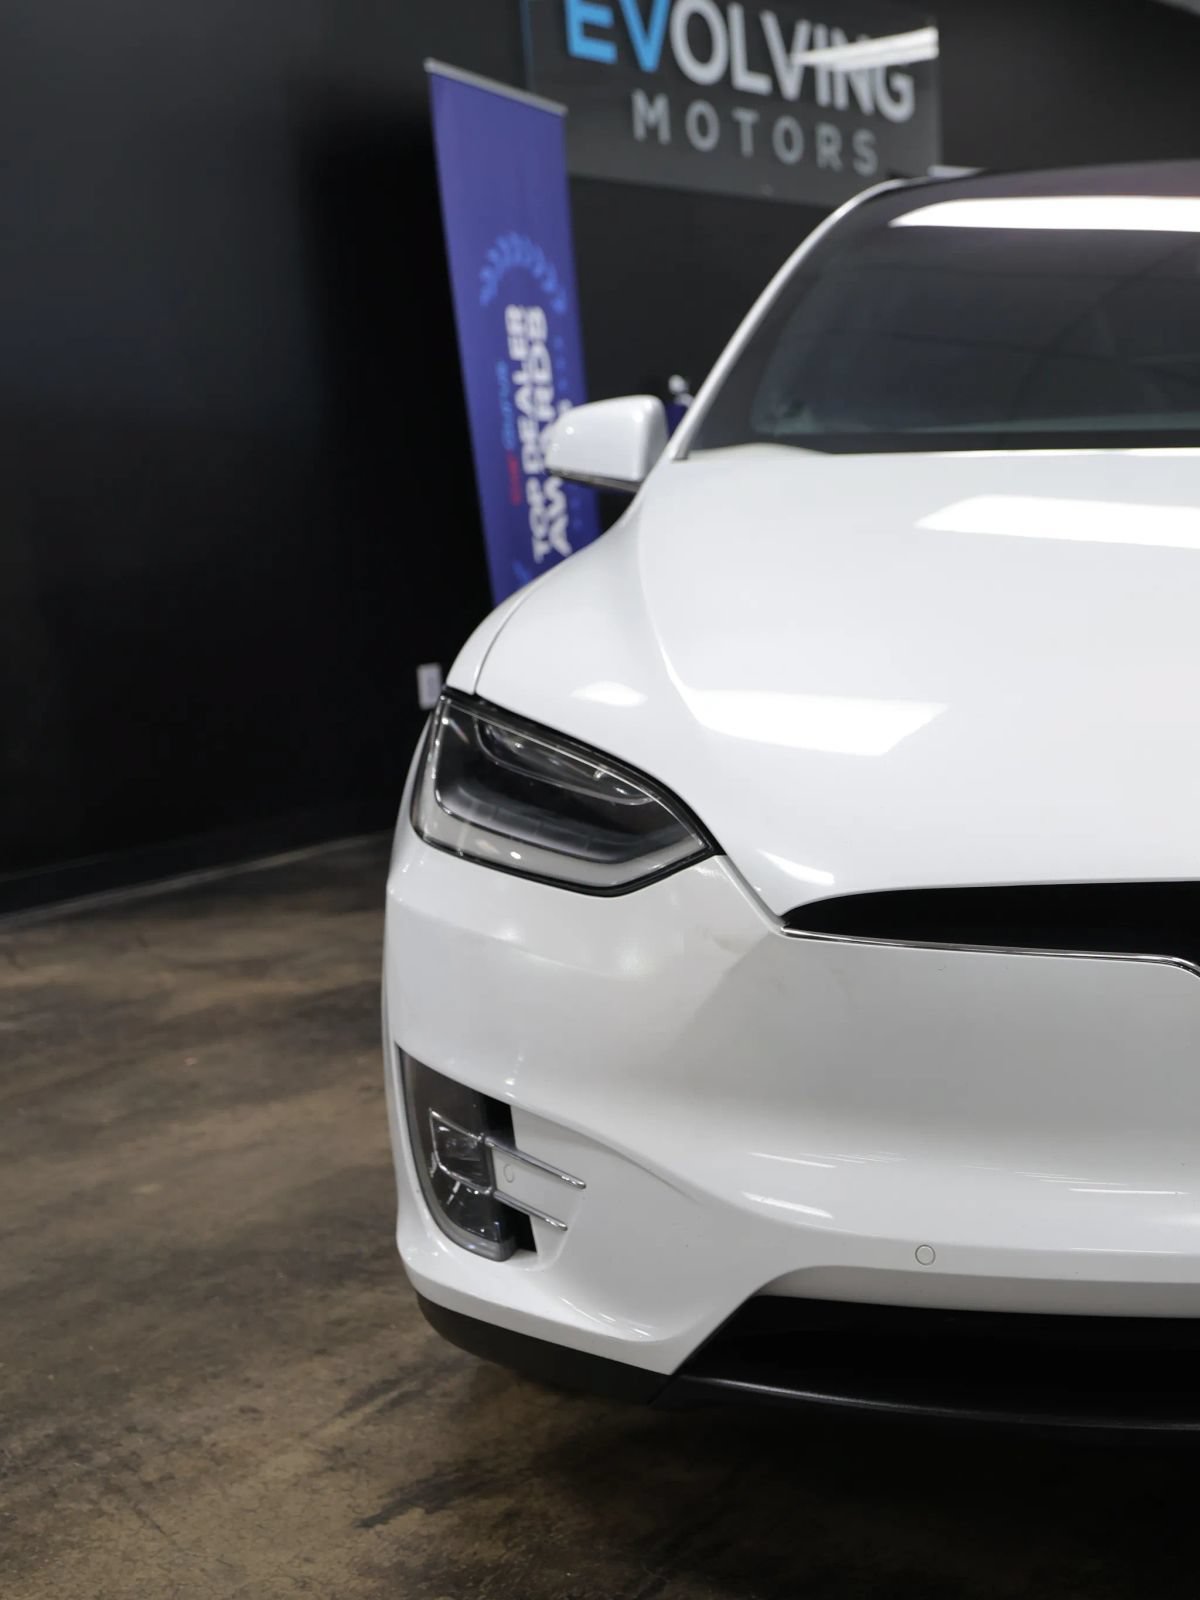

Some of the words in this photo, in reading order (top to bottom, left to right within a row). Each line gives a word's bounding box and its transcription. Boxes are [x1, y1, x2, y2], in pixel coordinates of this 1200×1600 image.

[565, 0, 915, 122] EVOLVING
[631, 90, 879, 176] MOTORS
[505, 304, 543, 474] DEALER
[526, 306, 572, 557] AWRDS
[525, 477, 551, 563] TOP
